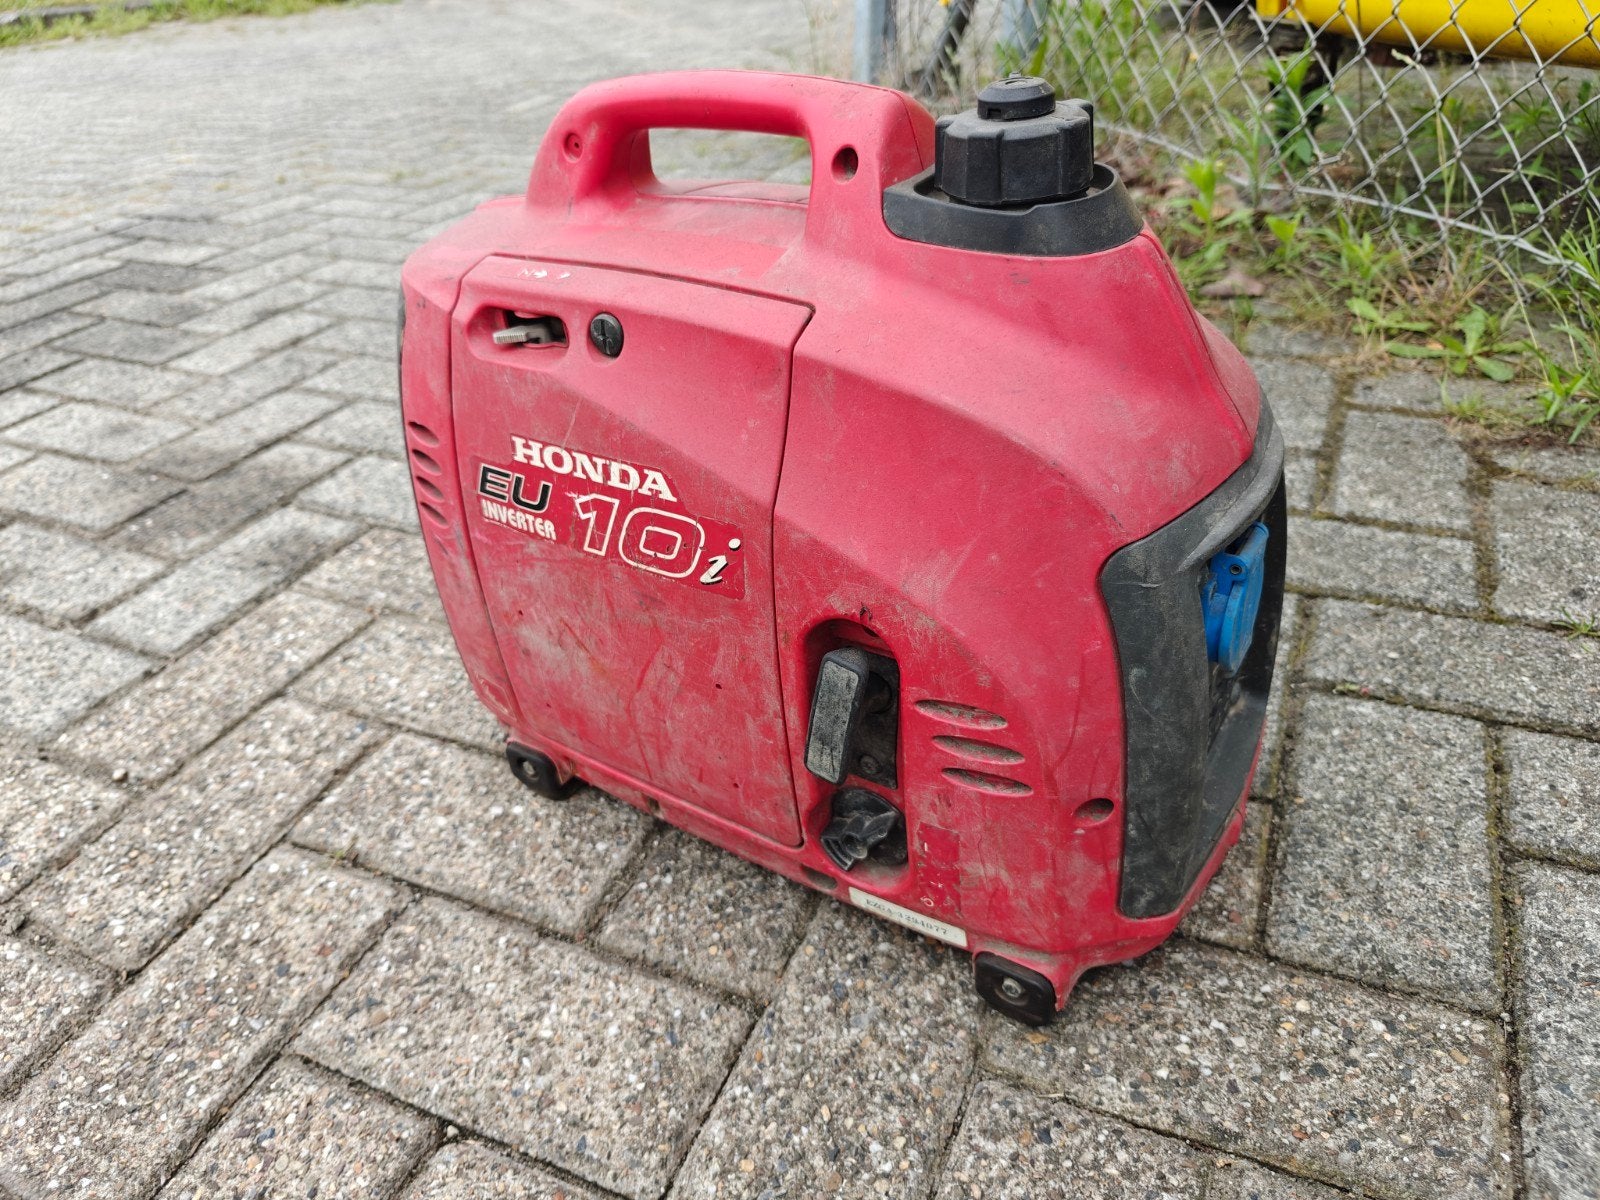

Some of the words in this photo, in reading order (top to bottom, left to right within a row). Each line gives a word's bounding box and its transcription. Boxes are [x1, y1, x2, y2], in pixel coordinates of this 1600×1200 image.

[478, 463, 552, 513] EU
[511, 435, 677, 502] HONDA
[481, 499, 556, 541] INVERTER
